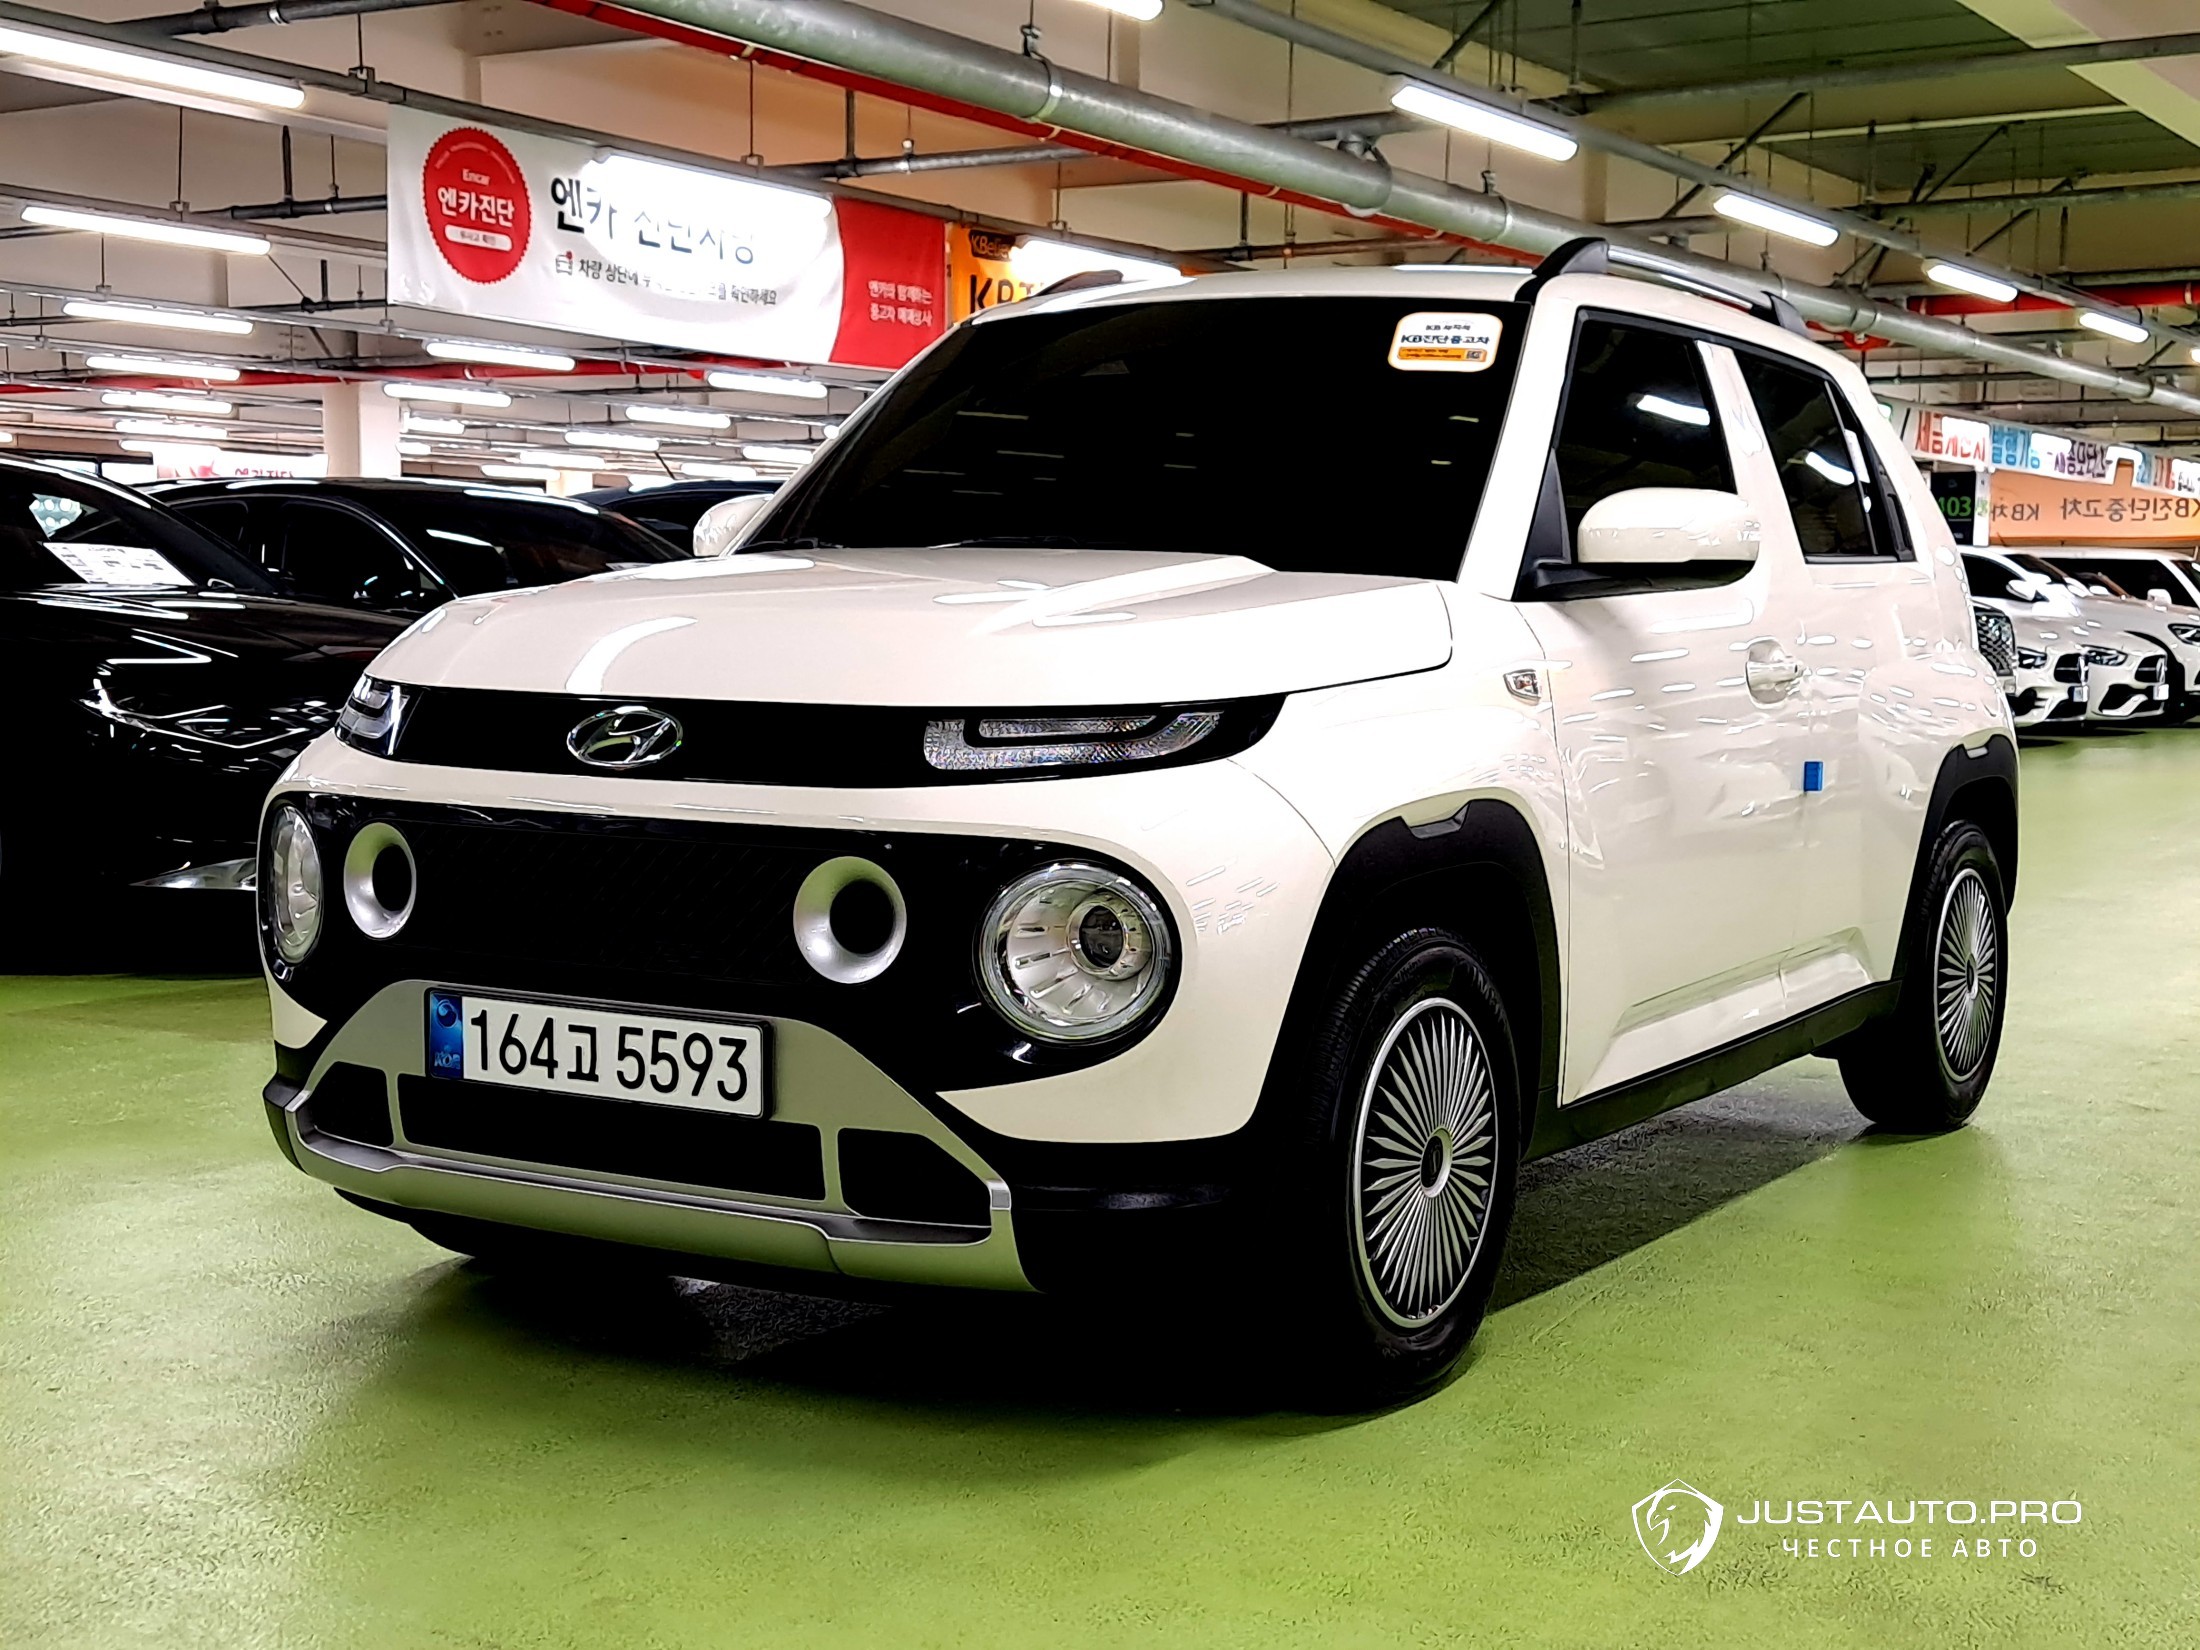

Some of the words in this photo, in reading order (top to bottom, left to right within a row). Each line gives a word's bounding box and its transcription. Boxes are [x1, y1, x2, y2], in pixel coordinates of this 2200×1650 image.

[437, 187, 515, 228] 엔카진단
[470, 1008, 600, 1083] 164고
[616, 1025, 748, 1102] 5593
